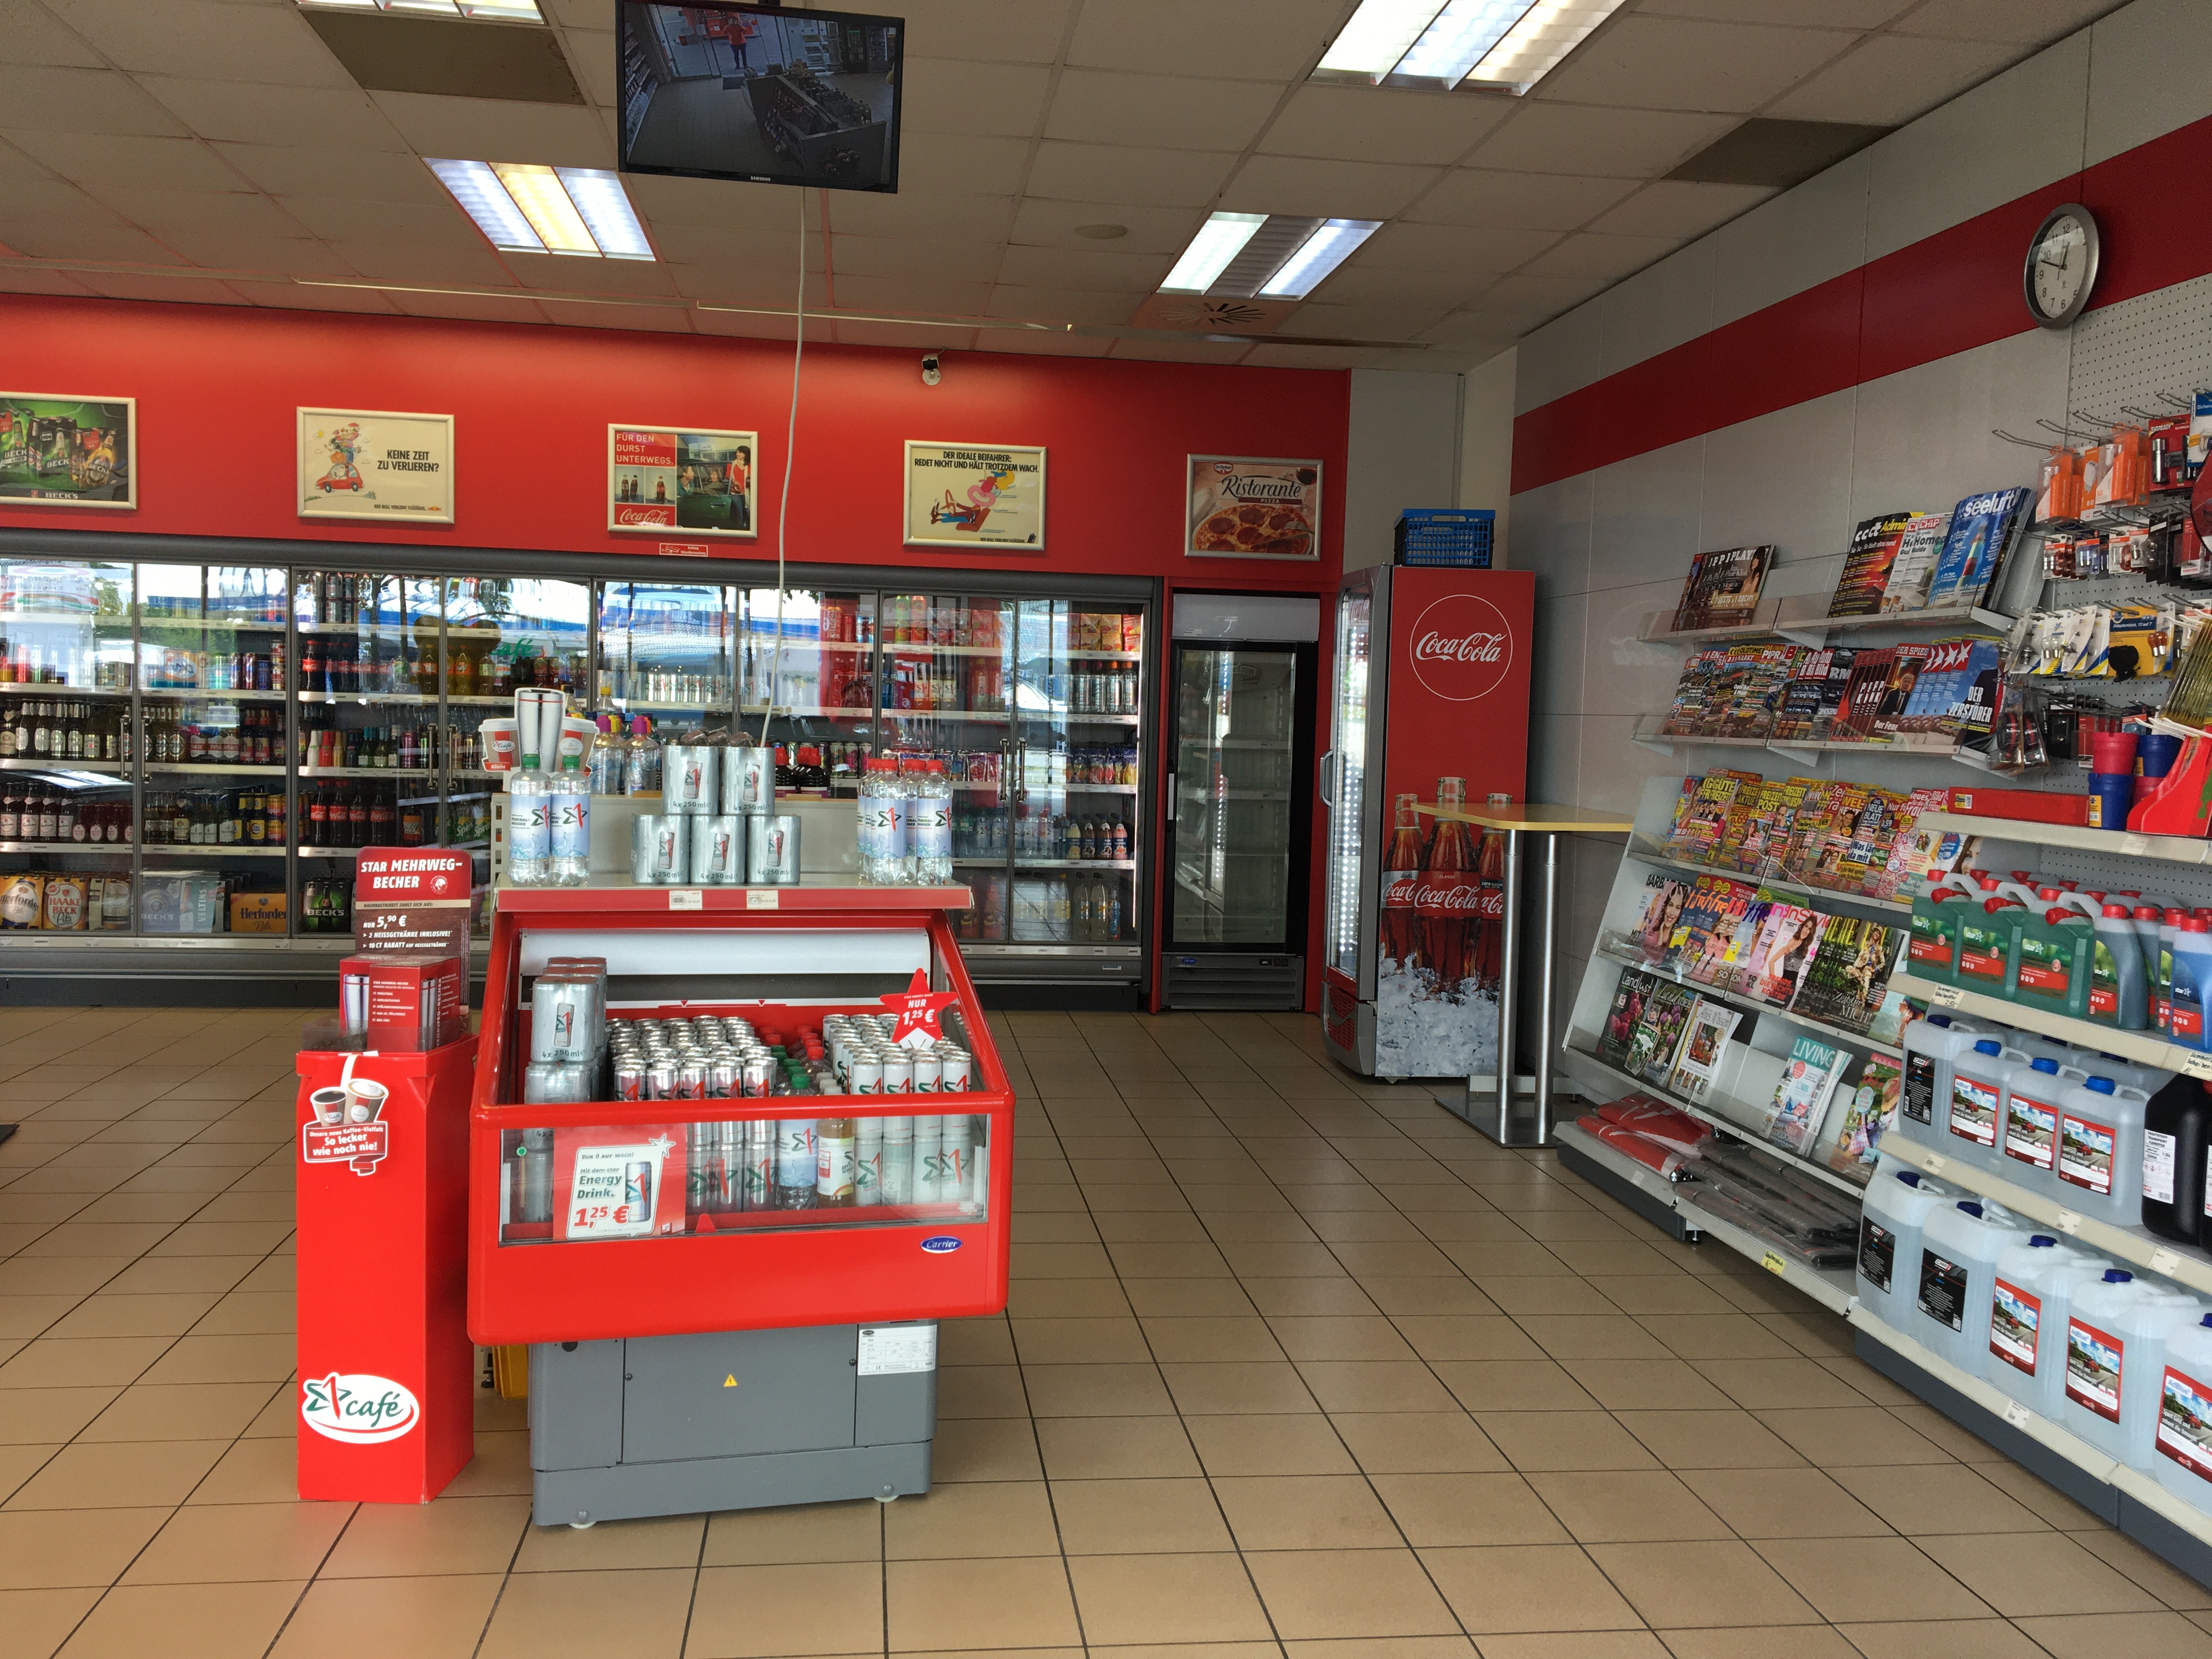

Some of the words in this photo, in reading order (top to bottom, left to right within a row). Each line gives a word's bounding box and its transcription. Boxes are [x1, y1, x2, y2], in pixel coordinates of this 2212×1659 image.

[2063, 223, 2070, 234] 12
[2044, 250, 2051, 261] 10
[2039, 269, 2044, 280] 9
[2042, 287, 2047, 297] 8
[2051, 298, 2055, 308] 7
[2061, 299, 2066, 309] 6
[616, 432, 634, 442] FÜR
[636, 435, 654, 443] DEN
[617, 444, 646, 453] DURST
[387, 449, 410, 460] KEINE
[413, 451, 430, 461] ZEIT
[617, 455, 674, 465] UNTERWEGS.
[943, 451, 955, 460] DER
[956, 452, 977, 460] IDEALE
[978, 453, 1012, 462] BEIFAHRER:
[377, 460, 389, 470] ZU
[391, 461, 439, 472] VERLIEREN?
[934, 459, 953, 468] NICHT
[954, 460, 968, 469] UND
[969, 460, 984, 470] HÄLT
[985, 462, 1018, 472] TROTZDEM
[1019, 464, 1039, 473] WACH.
[1221, 475, 1301, 498] Ristorante
[1963, 490, 2015, 517] seeluft
[619, 508, 670, 524] Coca-Cola
[1920, 518, 1940, 529] CHIP
[1416, 631, 1508, 662] Coca-Cola
[1968, 686, 1983, 702] DER
[1948, 702, 1993, 723] ZERSTÖRER
[1874, 720, 1884, 730] Der
[1756, 800, 1780, 811] POST
[1866, 804, 1884, 814] NEUE
[1888, 803, 1900, 811] Nur
[1864, 812, 1882, 822] BLATT
[1852, 840, 1865, 850] Was
[1857, 853, 1869, 862] mit
[361, 861, 387, 873] STAR
[391, 858, 462, 872] MEHRWEG-
[373, 876, 420, 889] BECHER
[49, 897, 81, 906] HAAKE
[1414, 884, 1481, 910] Coca-Cola
[53, 906, 77, 915] BECK
[198, 888, 207, 922] VELTINS
[56, 911, 72, 923] Pils
[306, 909, 345, 917] BECK'S
[398, 915, 407, 927] €
[908, 999, 927, 1008] NUR
[902, 1009, 923, 1026] 1,25
[924, 1009, 935, 1023] €
[1839, 1005, 1872, 1024] MICH!
[1793, 1039, 1835, 1068] LIVING
[343, 1126, 383, 1135] Kaffee-Vielfalt
[324, 1136, 336, 1146] So
[338, 1133, 367, 1144] lecker
[313, 1146, 331, 1156] wie
[334, 1143, 356, 1154] noch
[359, 1142, 377, 1152] nie!
[579, 1175, 622, 1186] Energy
[577, 1188, 614, 1199] Drink.
[574, 1206, 608, 1228] 1,25
[613, 1205, 630, 1224] €
[927, 1240, 958, 1249] Carrier
[2168, 1379, 2191, 1395] AdBlue
[346, 1391, 404, 1427] café
